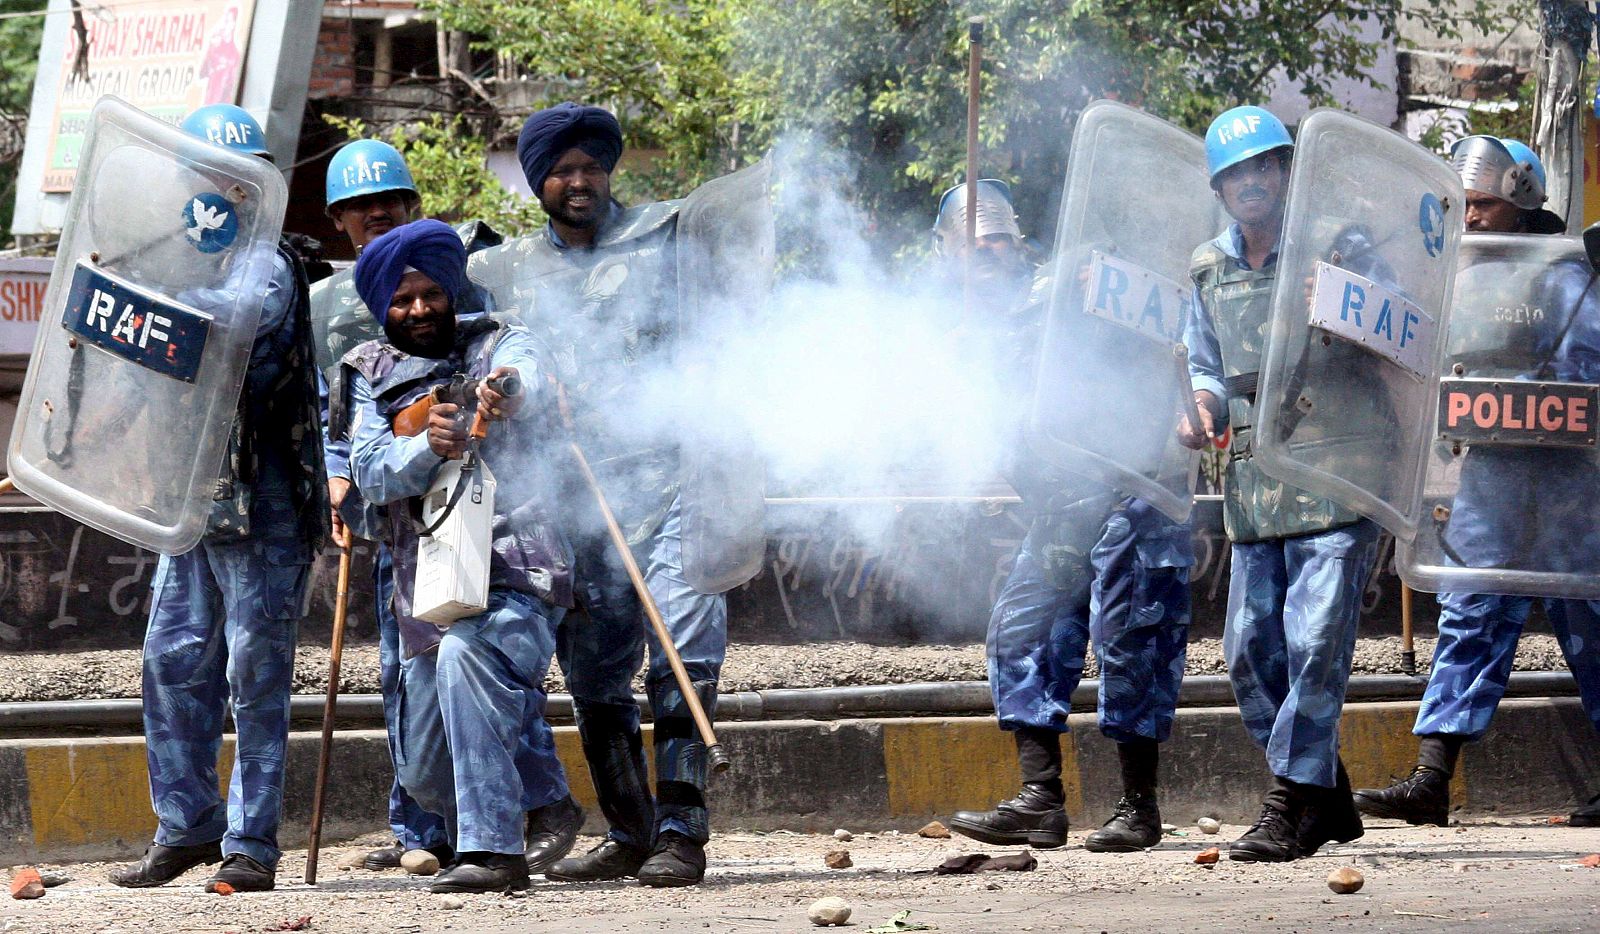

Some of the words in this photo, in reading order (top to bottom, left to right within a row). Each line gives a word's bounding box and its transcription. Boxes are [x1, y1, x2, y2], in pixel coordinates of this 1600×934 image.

[132, 13, 206, 56] SHARMA
[137, 66, 194, 97] GROUP
[205, 119, 252, 145] RAF
[1217, 115, 1261, 145] RAF
[342, 158, 388, 187] RAF
[86, 289, 172, 348] RAF
[1340, 281, 1419, 349] RAF
[1447, 392, 1589, 432] POLICE
